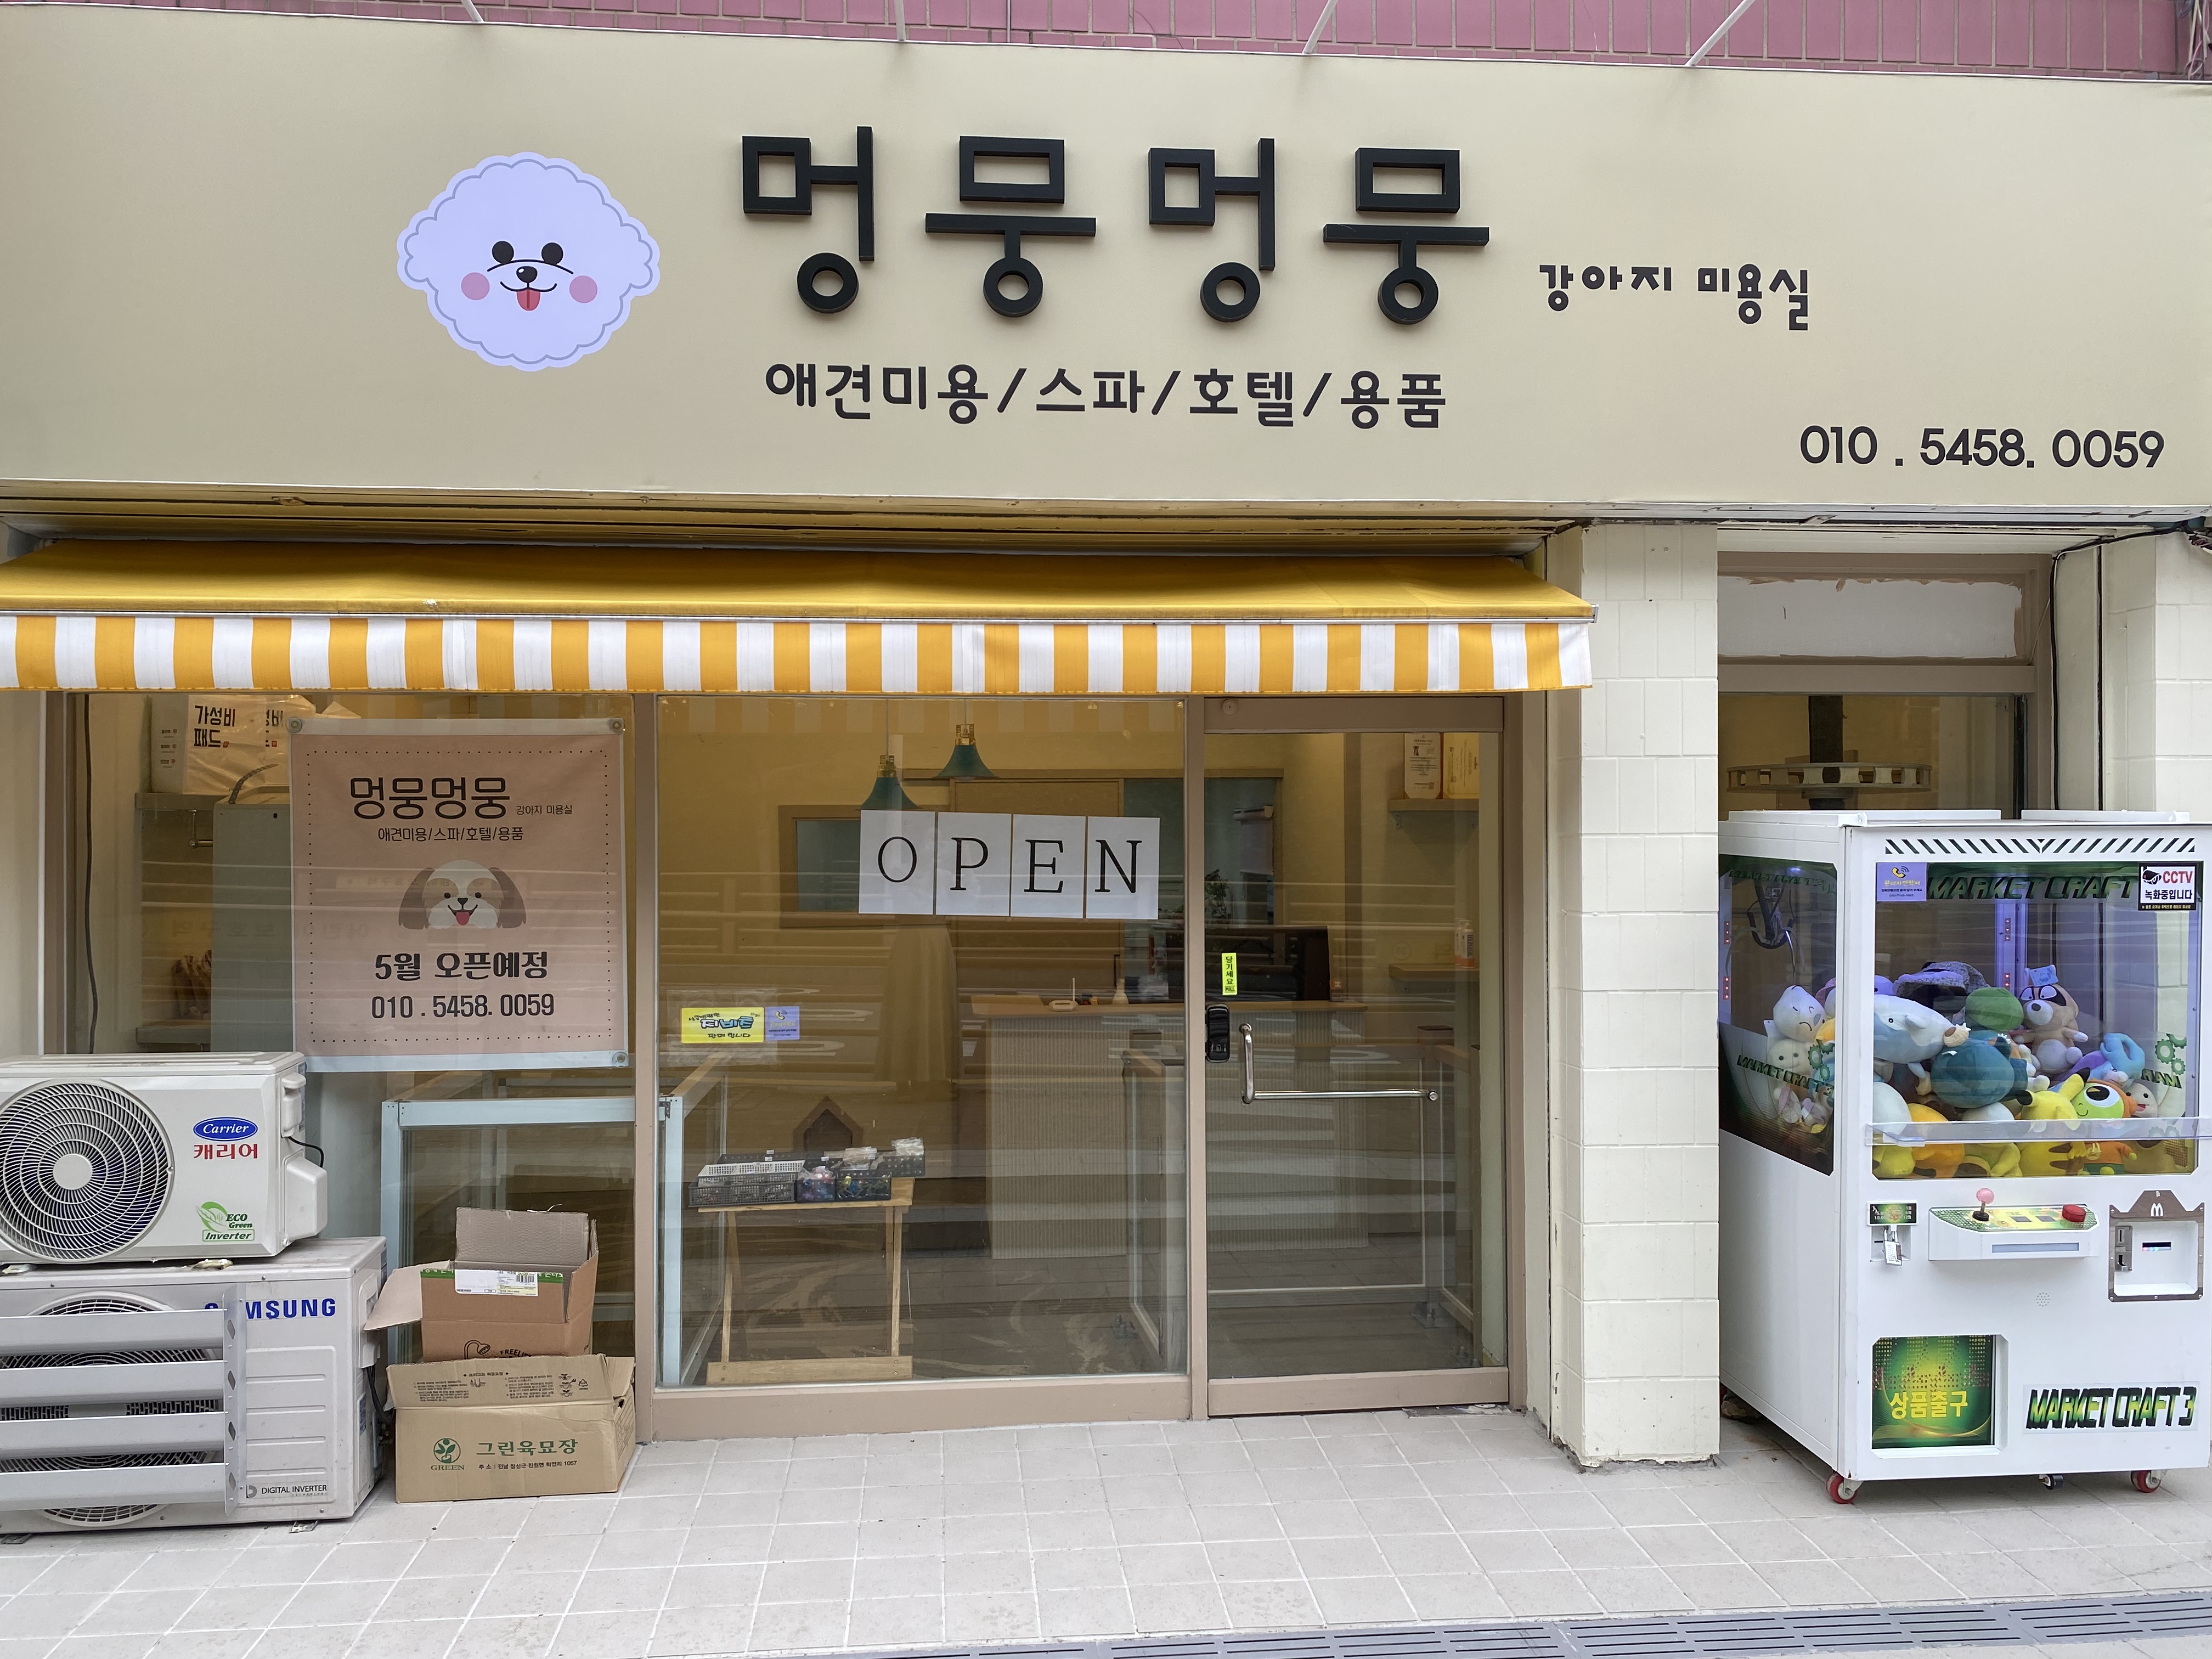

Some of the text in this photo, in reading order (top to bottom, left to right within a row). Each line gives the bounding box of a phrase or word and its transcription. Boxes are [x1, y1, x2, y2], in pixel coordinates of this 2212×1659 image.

[742, 126, 1489, 324] 멍뭉멍뭉
[1539, 263, 1808, 331] 강아지 미용실
[766, 364, 1446, 429] 애견미용/스파/호텔/용품
[1800, 426, 1877, 464] 010
[2052, 430, 2165, 469] 0059
[195, 706, 236, 727] 가성비
[194, 728, 221, 748] 패드
[351, 777, 573, 820] 멍뭉멍뭉 강아지 미용실
[379, 826, 524, 842] 애견미용/스파/호텔/용품
[878, 836, 1142, 894] OPEN
[1927, 877, 2138, 900] MARKET CRAFT
[2163, 871, 2193, 884] CCTV
[2145, 889, 2193, 900] 녹화중입니다
[375, 951, 548, 981] 5월 오픈예정
[1226, 956, 1234, 985] 당기세요
[372, 996, 413, 1018] 010
[500, 994, 554, 1017] 0059
[1737, 1054, 1784, 1080] MARKET
[203, 1123, 249, 1134] Carrier
[193, 1143, 258, 1160] 캐리어
[225, 1214, 248, 1222] ECO
[205, 1232, 252, 1240] Inverter
[205, 1297, 336, 1320] MSUNG
[1890, 1391, 1968, 1420] 상품출구
[2025, 1386, 2197, 1429] MARKET CRAFT 3
[476, 1438, 578, 1457] 그린육묘장
